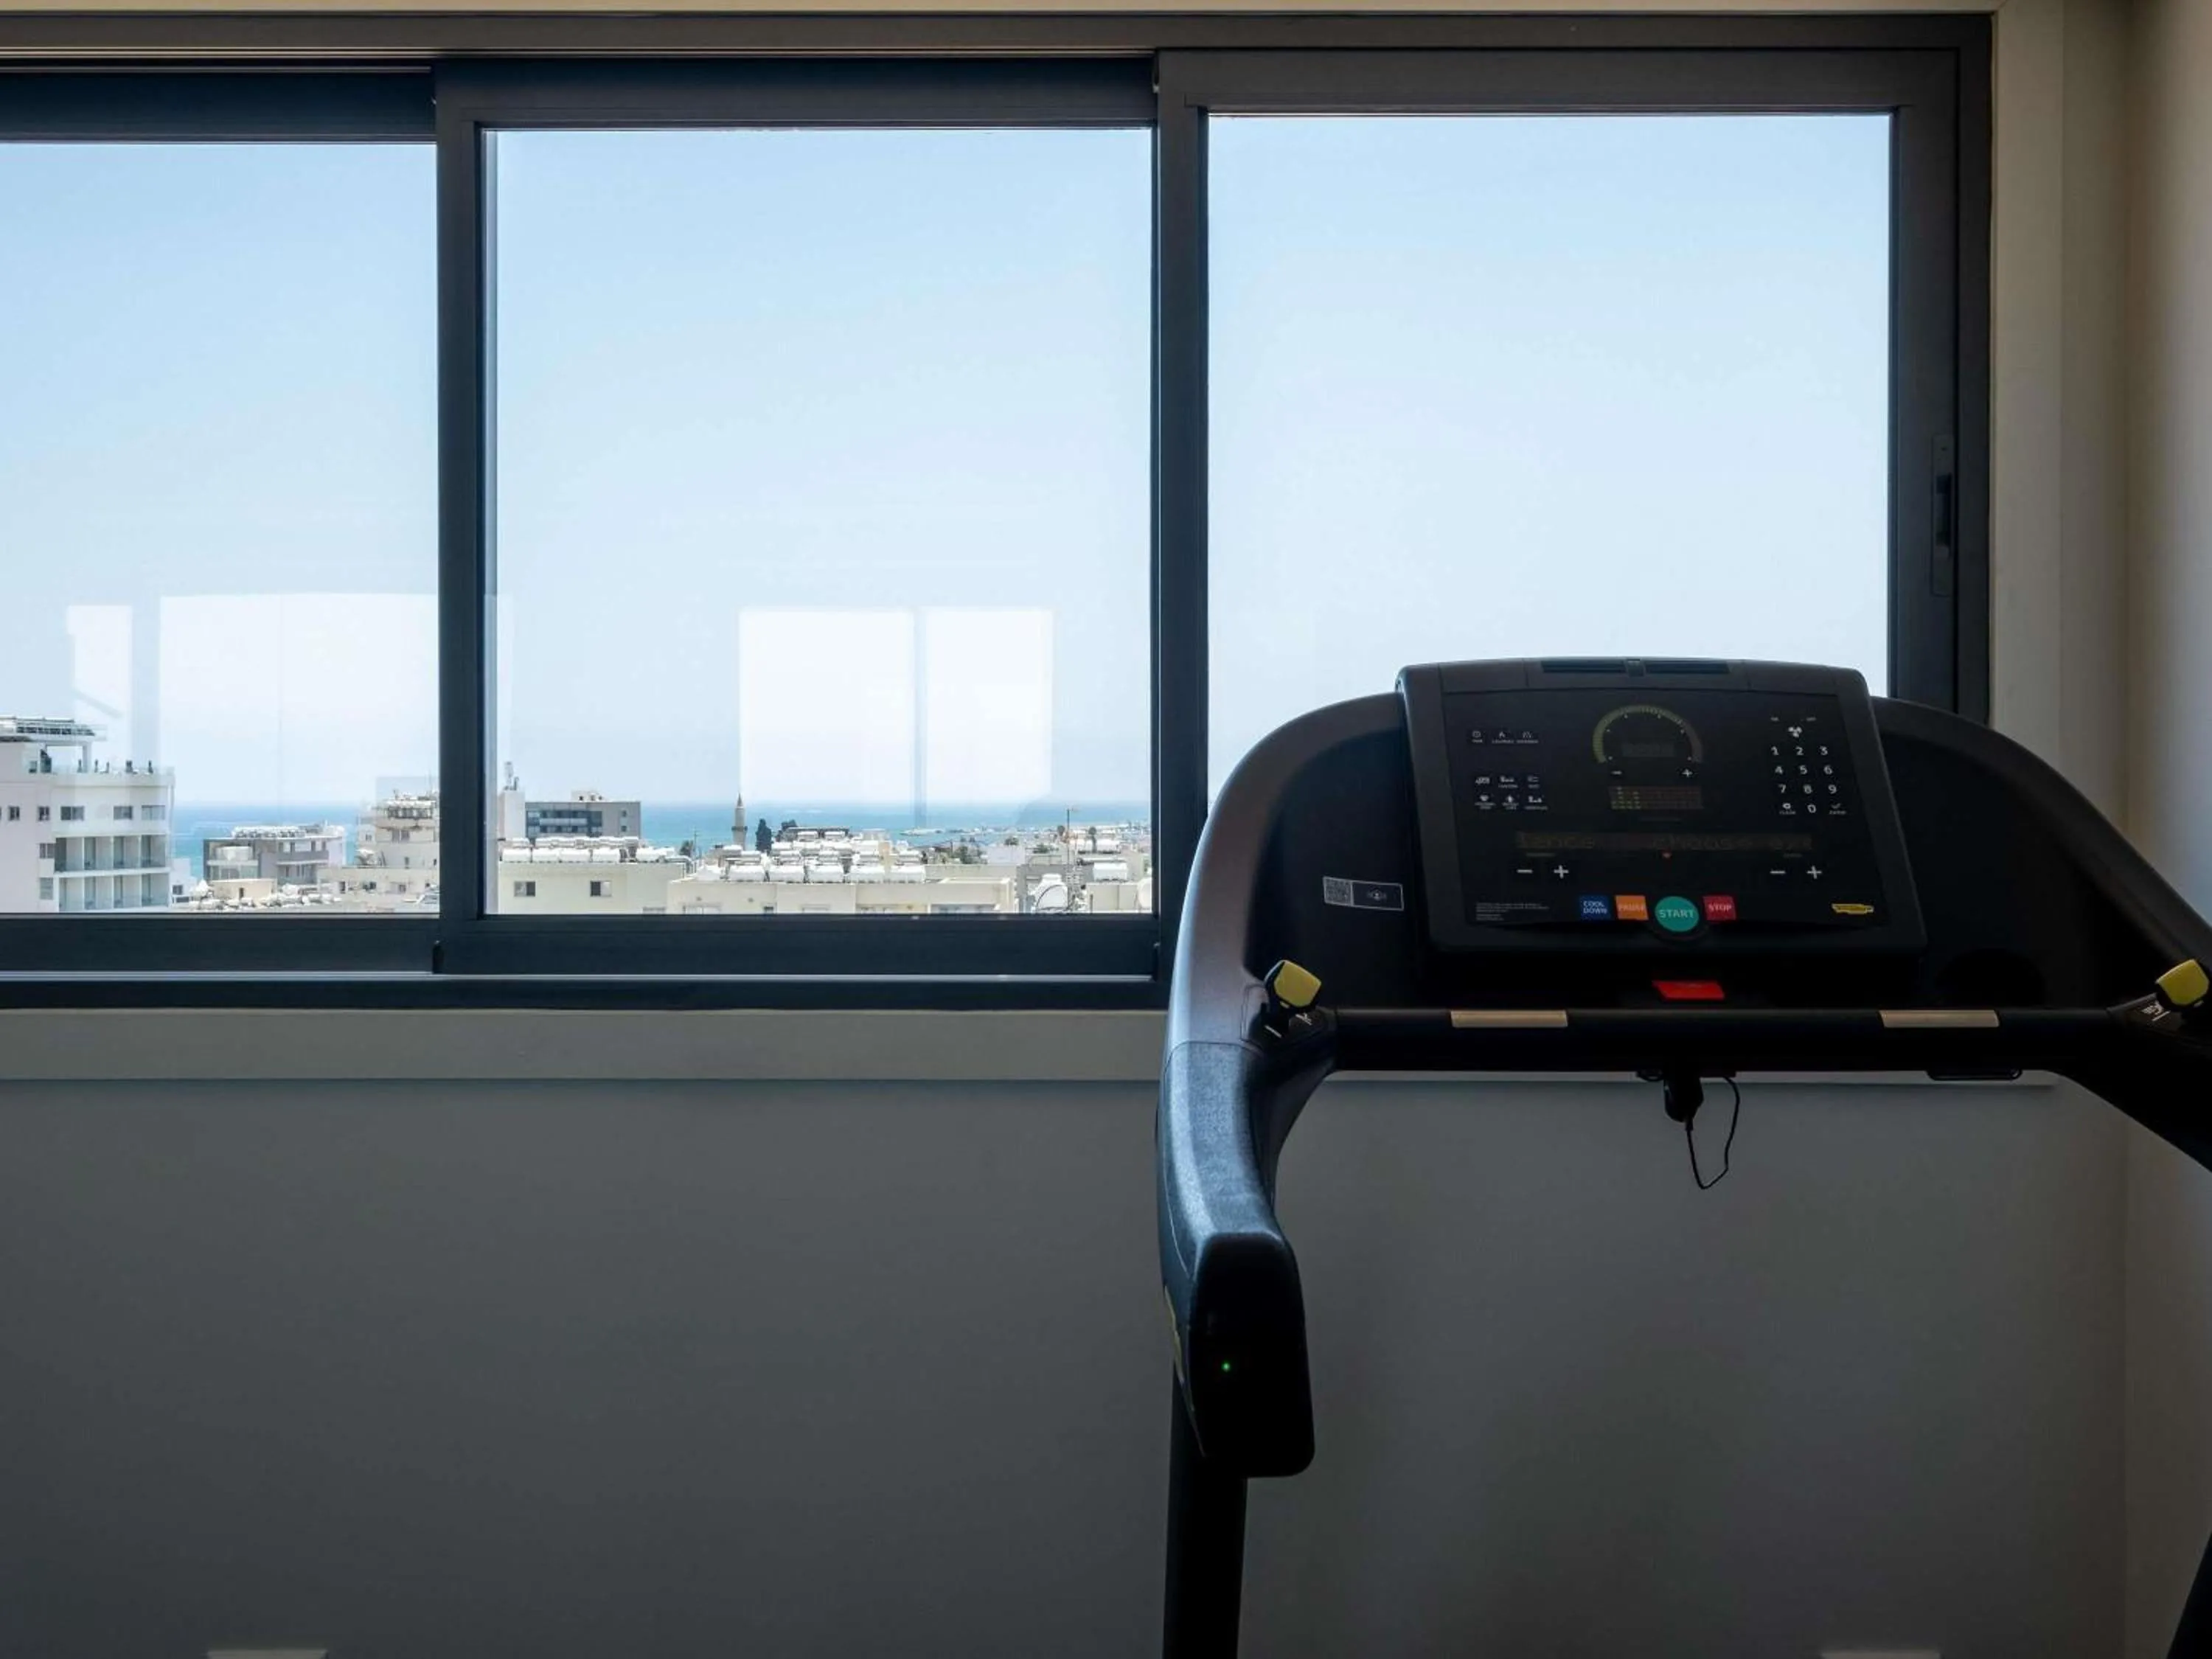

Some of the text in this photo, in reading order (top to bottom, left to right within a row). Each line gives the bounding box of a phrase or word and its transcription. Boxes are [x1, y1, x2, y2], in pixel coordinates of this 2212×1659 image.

[1770, 745, 1829, 756] 1 2 3
[1775, 765, 1833, 775] 4 5 6
[1778, 783, 1837, 794] 7 8 9
[1806, 804, 1817, 814] 0
[1618, 902, 1644, 913] PAUSE
[1708, 903, 1732, 913] STOP
[1659, 908, 1694, 919] START
